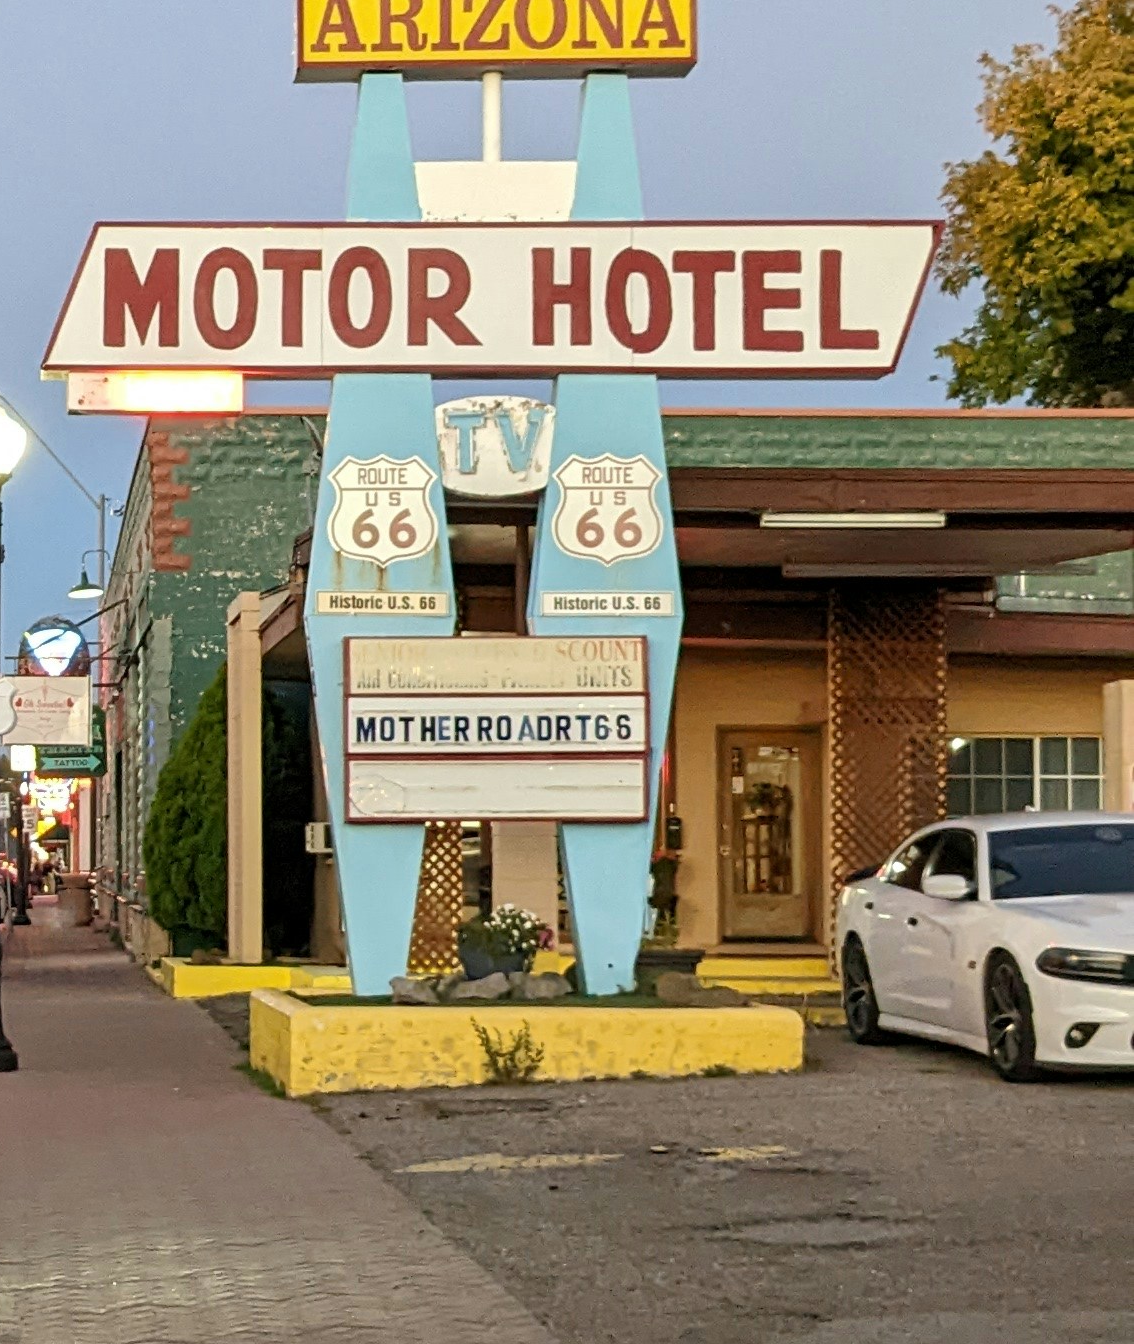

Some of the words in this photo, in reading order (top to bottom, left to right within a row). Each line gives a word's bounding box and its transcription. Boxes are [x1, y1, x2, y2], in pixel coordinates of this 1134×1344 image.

[102, 246, 483, 350] MOTOR
[531, 246, 880, 354] HOTEL
[443, 408, 547, 475] TV
[357, 467, 408, 485] ROUTE
[582, 466, 634, 484] ROUTE
[352, 508, 417, 549] 66
[576, 507, 643, 548] 66
[329, 595, 383, 609] Historic
[387, 596, 415, 609] U.S.
[419, 597, 437, 610] 66
[553, 596, 608, 610] Historic
[612, 596, 639, 610] U.S.
[644, 597, 661, 610] 66
[535, 640, 641, 662] SCOUNT
[575, 664, 633, 688] UNITS
